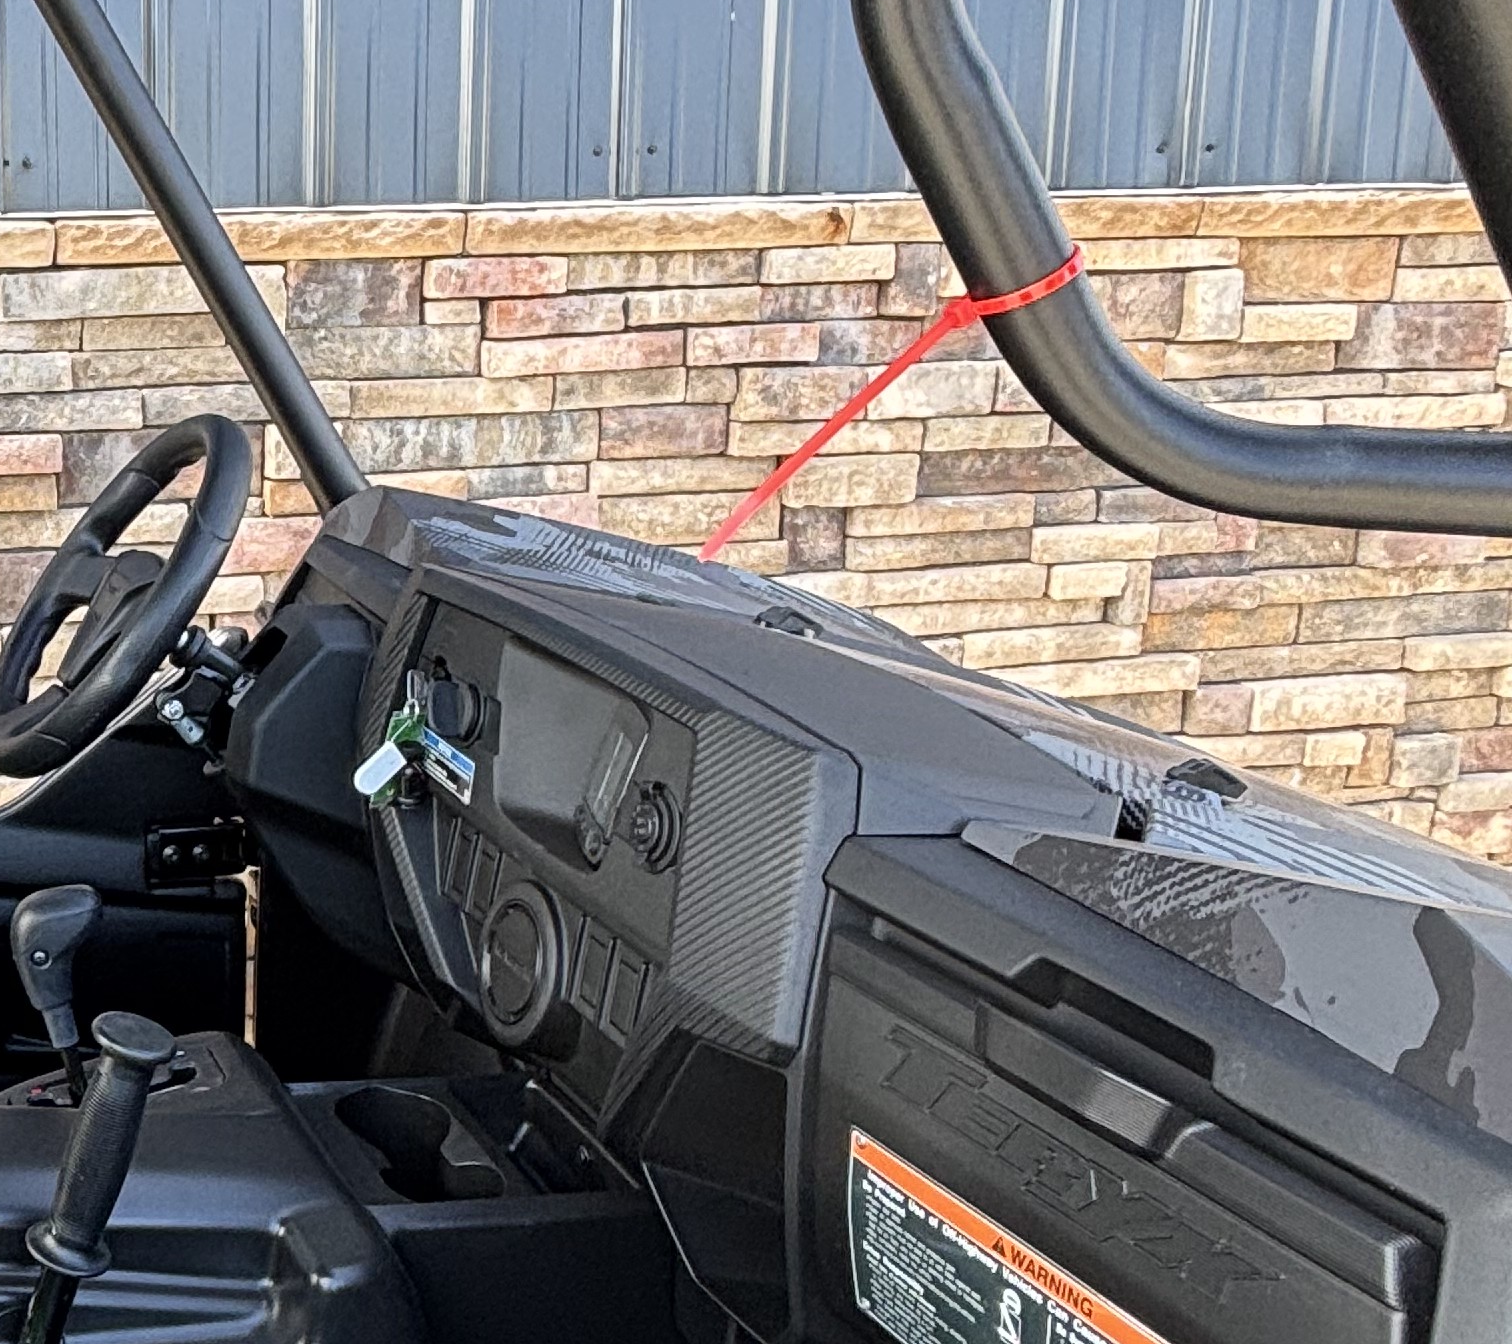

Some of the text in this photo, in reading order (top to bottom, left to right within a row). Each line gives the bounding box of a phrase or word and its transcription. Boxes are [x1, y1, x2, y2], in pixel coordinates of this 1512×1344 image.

[880, 1022, 1287, 1306] TERYX
[908, 1198, 926, 1220] Use
[928, 1216, 939, 1229] of
[942, 1223, 999, 1274] Off-Highway
[1002, 1265, 1044, 1305] Vehicles
[1047, 1299, 1070, 1323] Can
[1010, 1244, 1092, 1318] WARNING
